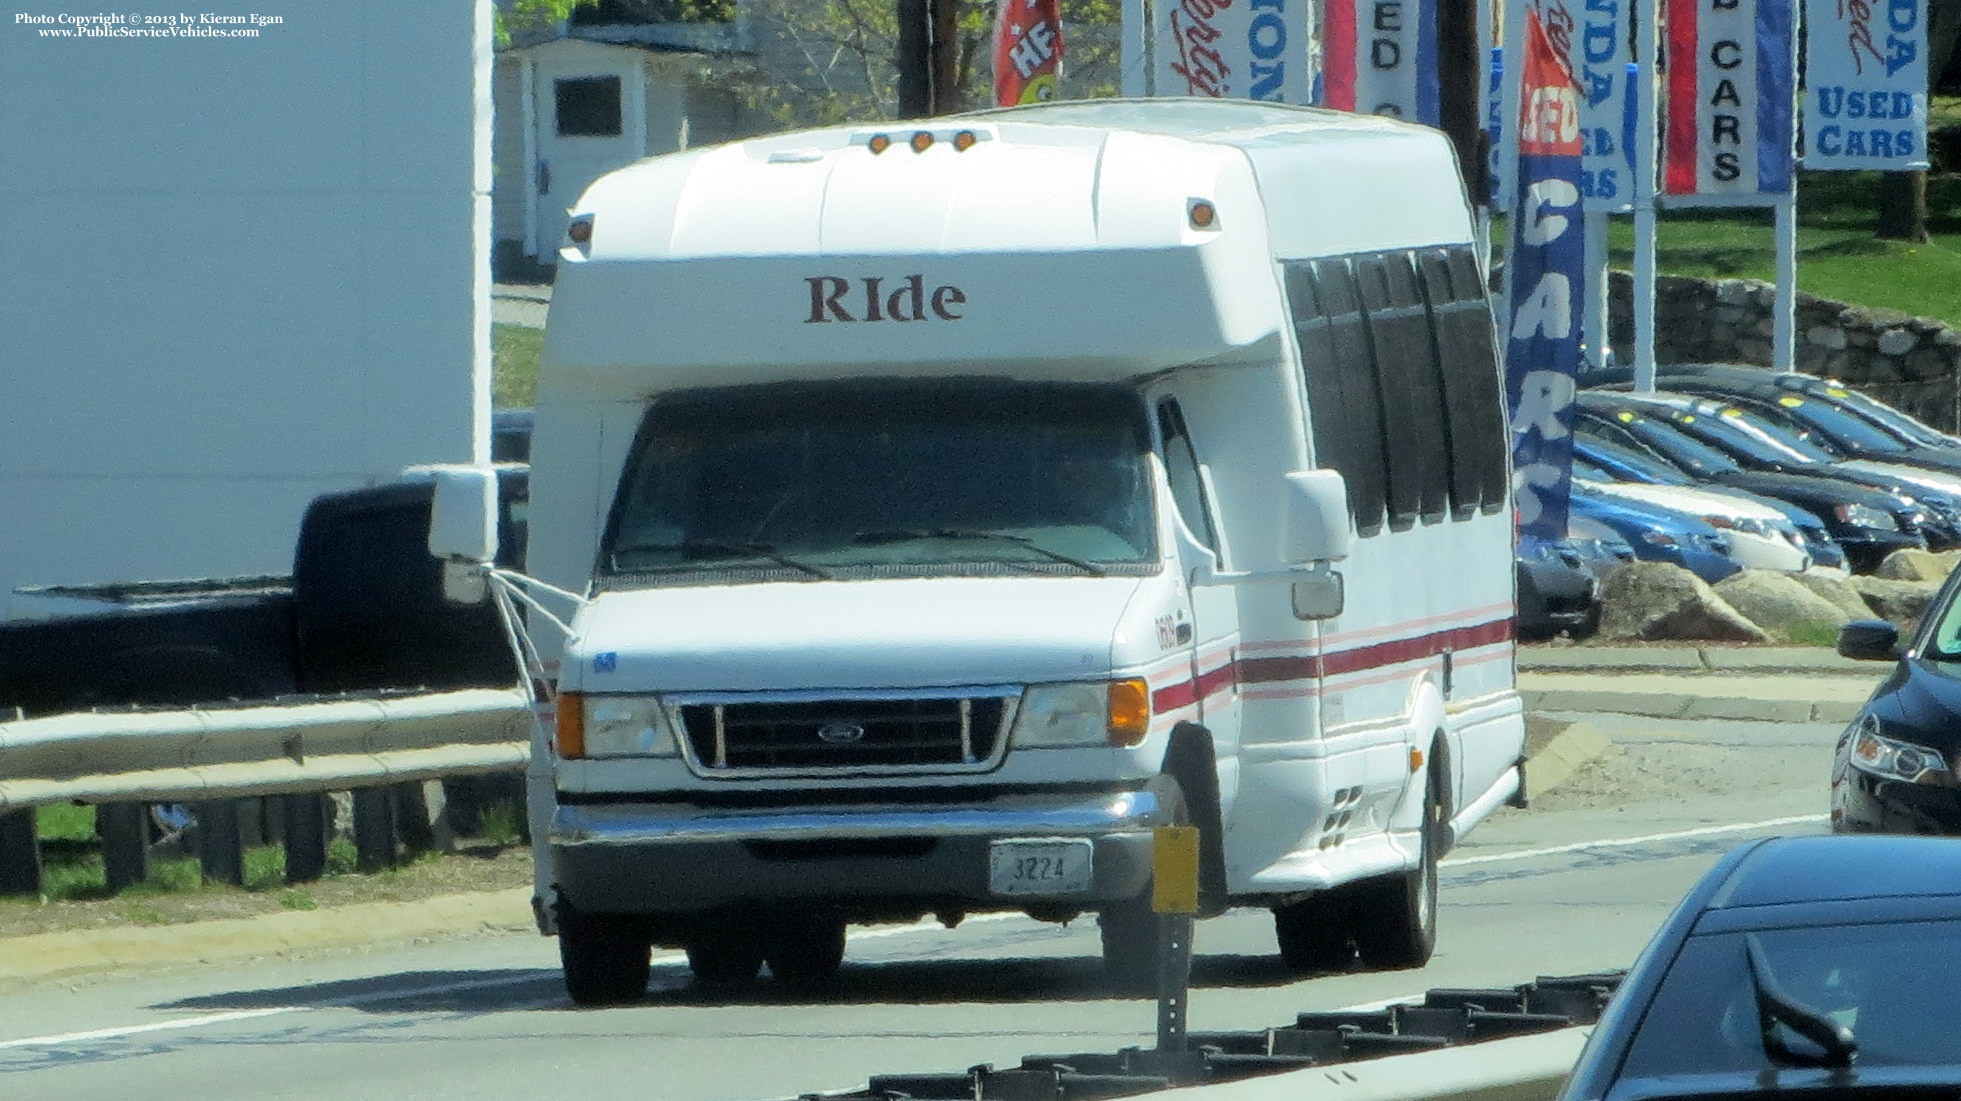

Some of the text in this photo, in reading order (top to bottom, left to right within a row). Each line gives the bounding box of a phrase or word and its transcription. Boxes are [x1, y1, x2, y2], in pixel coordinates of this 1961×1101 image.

[1710, 40, 1741, 181] CARS
[1818, 86, 1914, 119] USED
[1816, 125, 1914, 158] CARS
[1014, 857, 1064, 880] 3224
